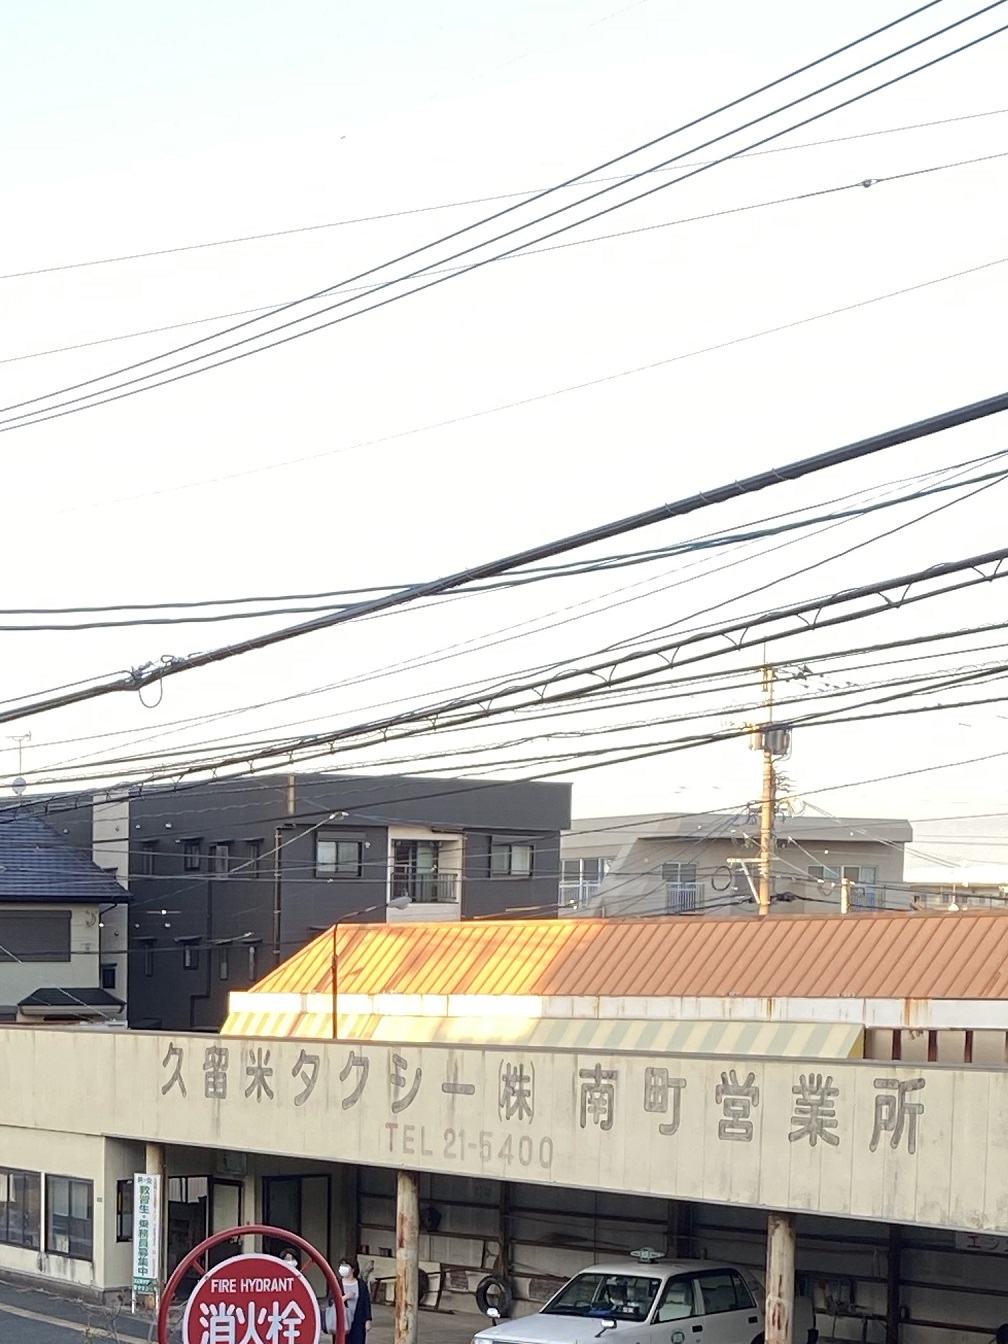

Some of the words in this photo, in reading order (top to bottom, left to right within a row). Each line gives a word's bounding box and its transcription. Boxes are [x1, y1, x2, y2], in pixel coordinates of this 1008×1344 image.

[385, 1122, 434, 1157] TEL
[443, 1127, 554, 1168] 21-5400
[210, 1278, 237, 1293] FIRE
[240, 1277, 295, 1293] HYDRANT
